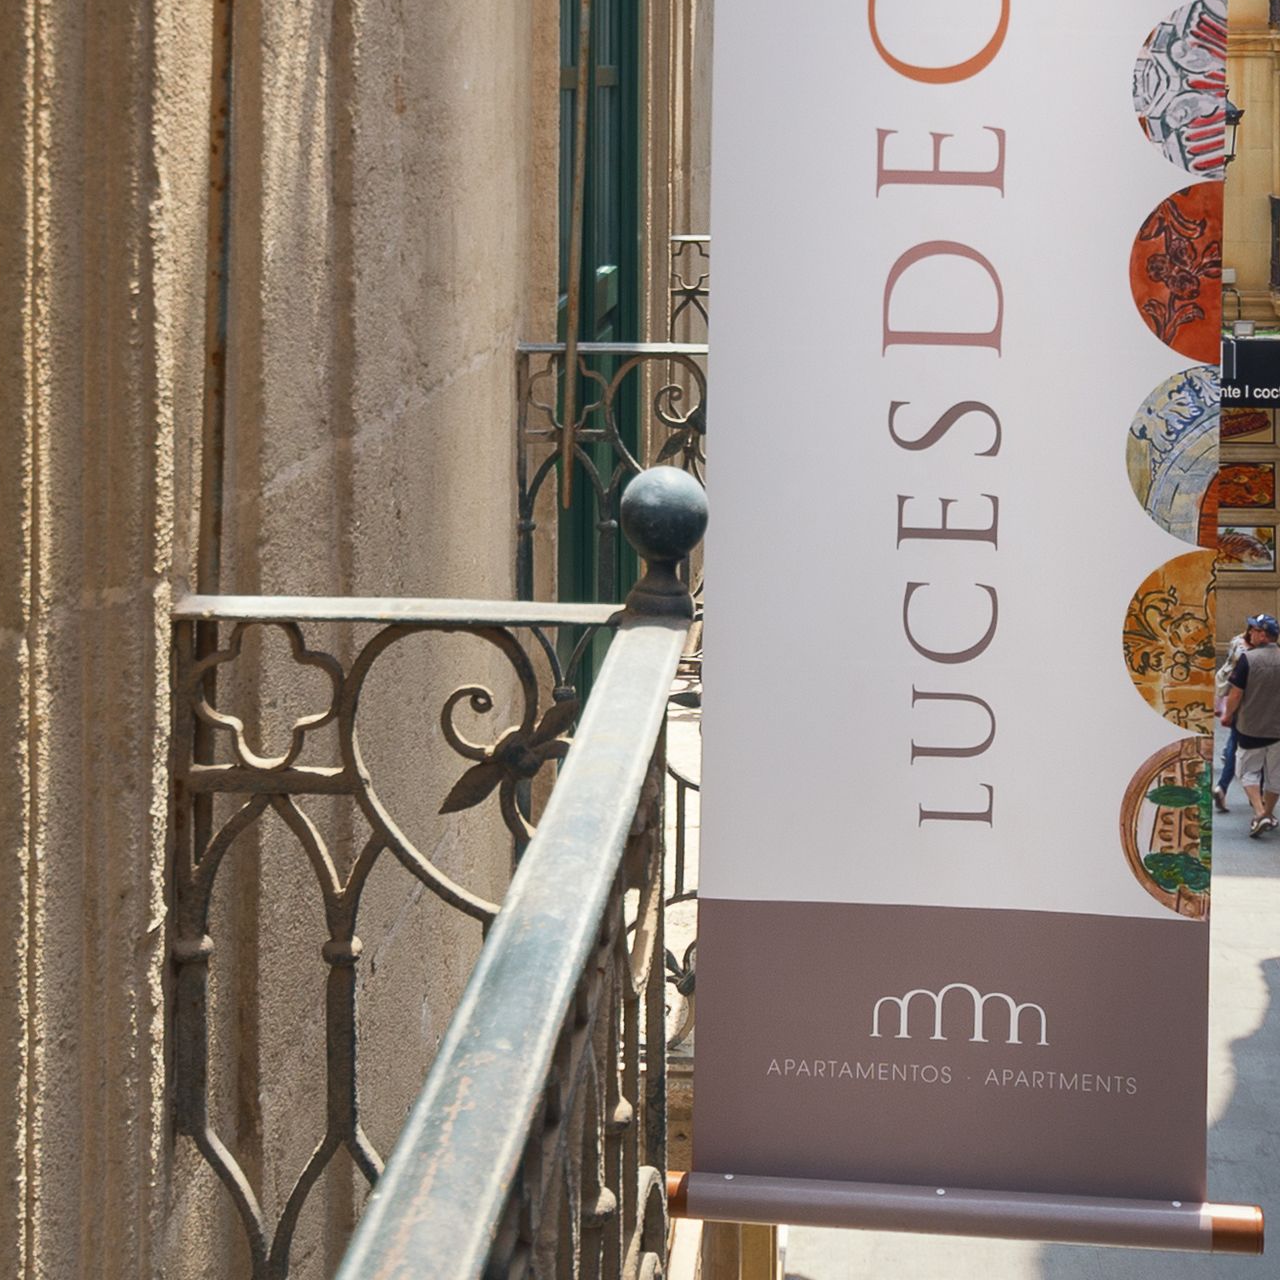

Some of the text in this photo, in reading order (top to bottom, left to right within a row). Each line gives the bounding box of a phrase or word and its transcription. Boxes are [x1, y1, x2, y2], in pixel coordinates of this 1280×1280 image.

[875, 125, 1007, 359] DE
[887, 399, 1003, 829] LUCES
[766, 1057, 1138, 1095] APARTAMENTOS APARTMENTS
